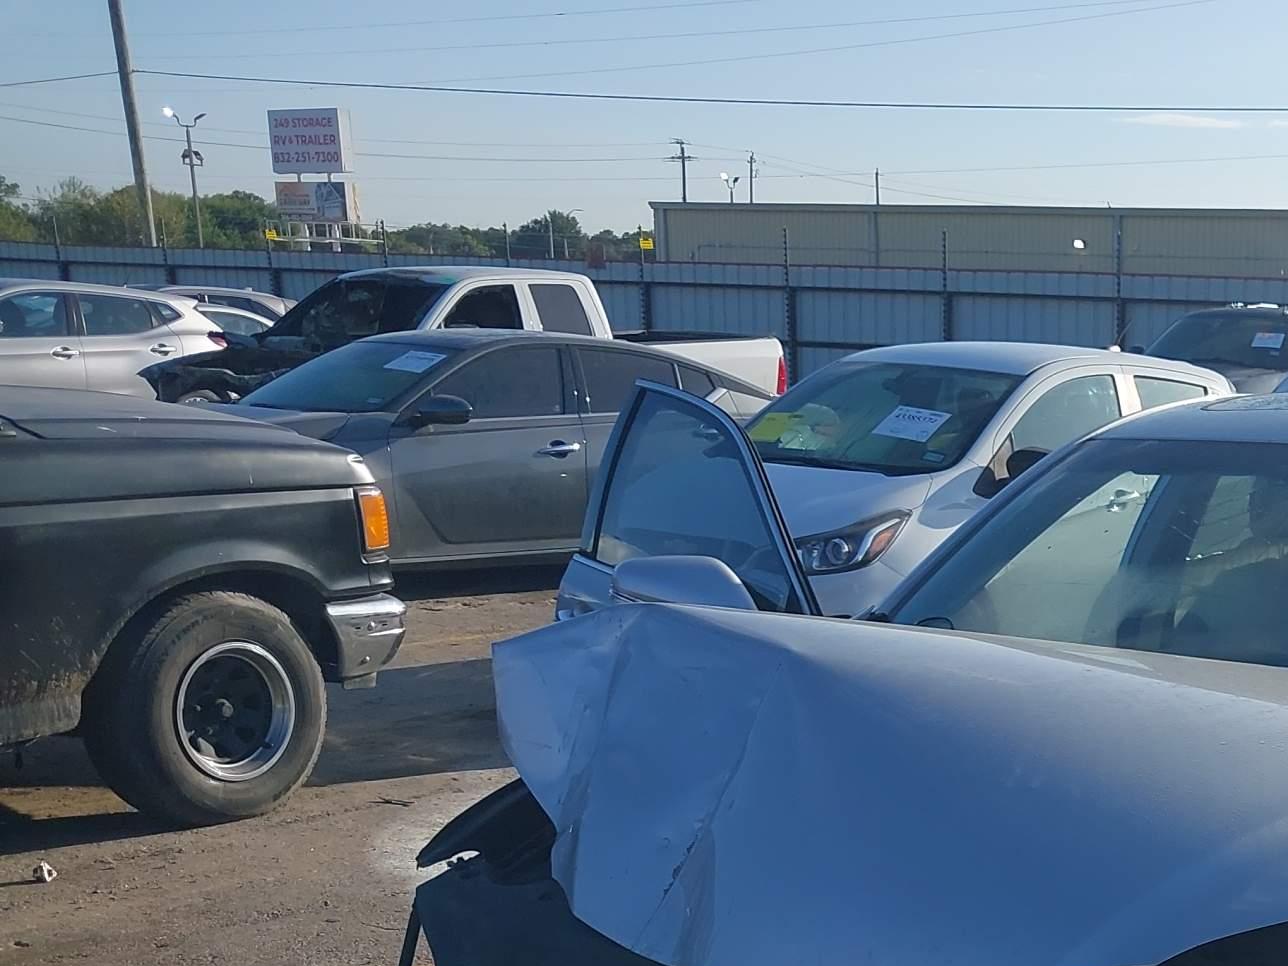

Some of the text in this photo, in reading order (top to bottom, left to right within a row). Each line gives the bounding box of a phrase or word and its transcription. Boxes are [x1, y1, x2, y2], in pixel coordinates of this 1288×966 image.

[273, 117, 333, 129] 249 STORAGE
[273, 135, 287, 146] RV
[294, 134, 336, 146] TRAILER
[273, 152, 339, 164] 832-251-7300
